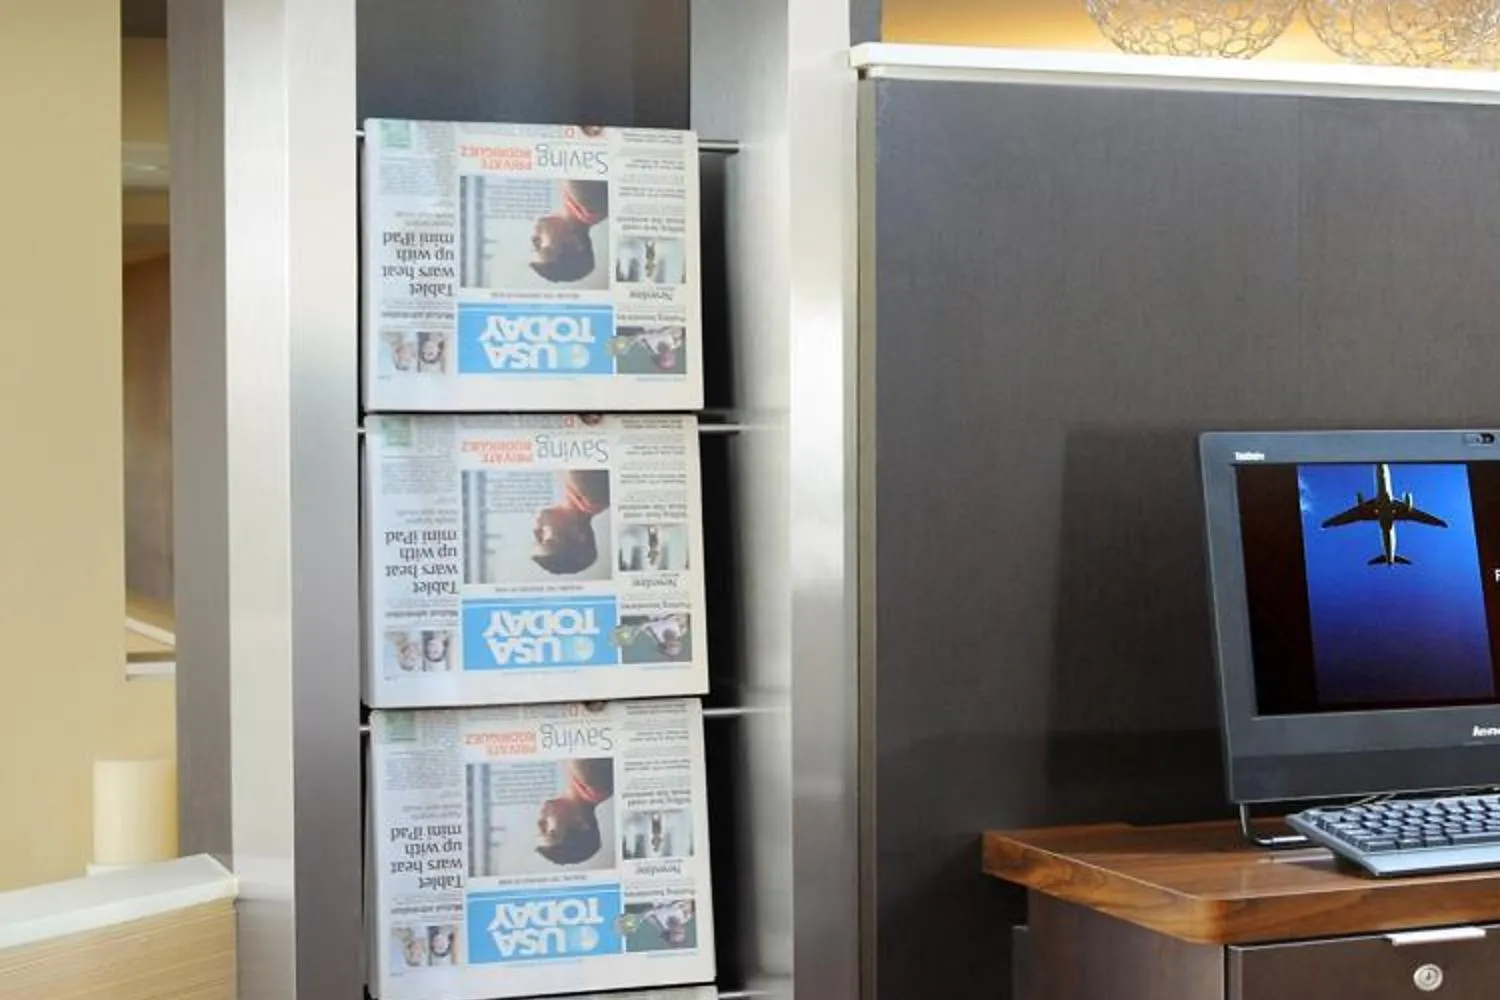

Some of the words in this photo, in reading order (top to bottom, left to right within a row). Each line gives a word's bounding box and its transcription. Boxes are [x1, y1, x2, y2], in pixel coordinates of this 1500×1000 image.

[535, 145, 609, 174] Saving
[382, 231, 415, 245] iPad
[419, 232, 454, 245] mini
[396, 248, 430, 263] with
[435, 246, 455, 260] up
[381, 265, 415, 280] heat
[419, 266, 455, 277] wars
[408, 283, 453, 296] Tablet
[477, 315, 595, 342] TODAY
[480, 343, 558, 369] USA
[535, 435, 609, 463] Saving
[385, 531, 417, 545] iPad
[421, 529, 458, 544] mini
[399, 547, 433, 562] with
[437, 545, 457, 557] up
[385, 564, 417, 579] heat
[421, 564, 458, 576] wars
[413, 581, 457, 594] Tablet
[482, 608, 600, 636] TODAY
[487, 636, 562, 664] USA
[540, 724, 613, 751] Saving
[390, 826, 424, 841] iPad
[427, 824, 462, 838] mini
[405, 842, 439, 857] with
[442, 840, 463, 852] up
[390, 860, 424, 875] heat
[427, 860, 463, 871] wars
[418, 875, 463, 890] Tablet
[487, 898, 604, 929] TODAY
[491, 929, 566, 957] USA
